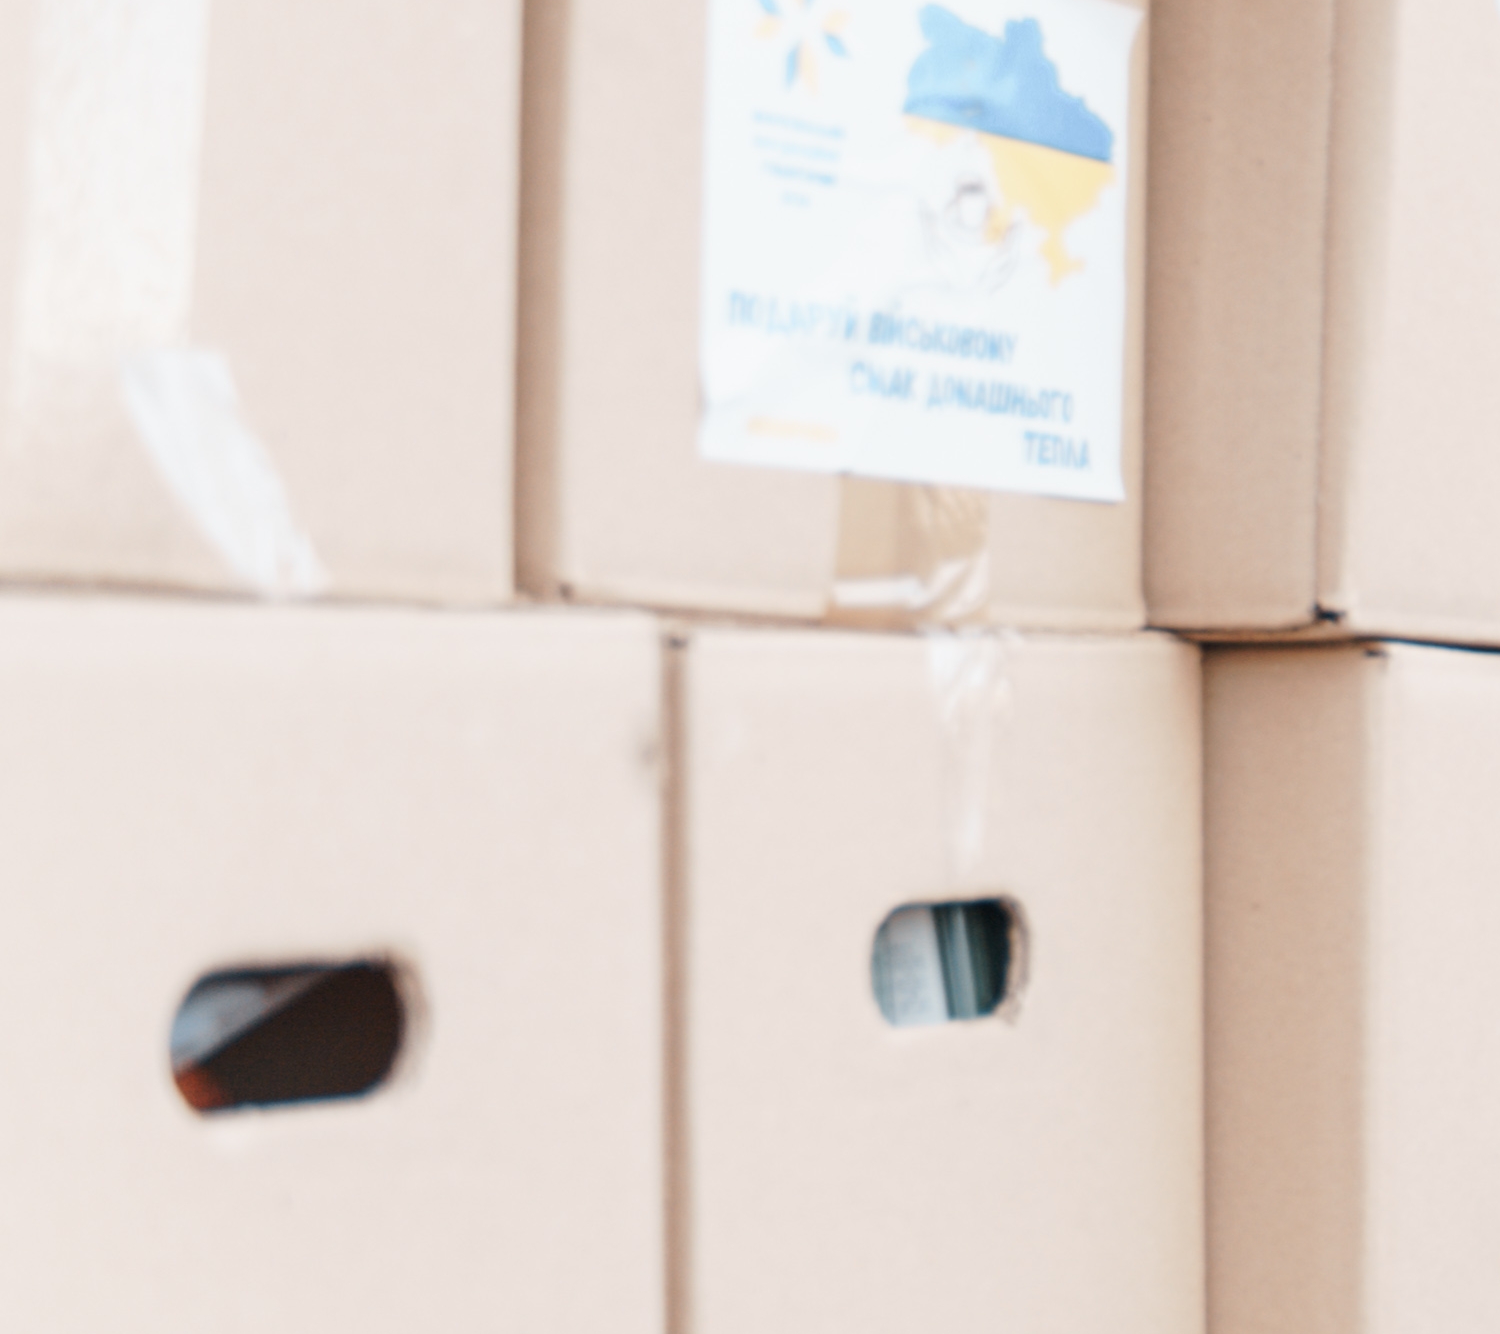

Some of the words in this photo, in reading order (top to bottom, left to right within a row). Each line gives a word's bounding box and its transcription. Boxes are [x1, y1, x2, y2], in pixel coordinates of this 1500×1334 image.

[868, 301, 1019, 364] ВІЙСЬКОВОМУ
[849, 361, 916, 401] СМАК
[927, 373, 1075, 423] ДОМАШНЬОГО
[1023, 430, 1091, 469] ТЕПЛА
